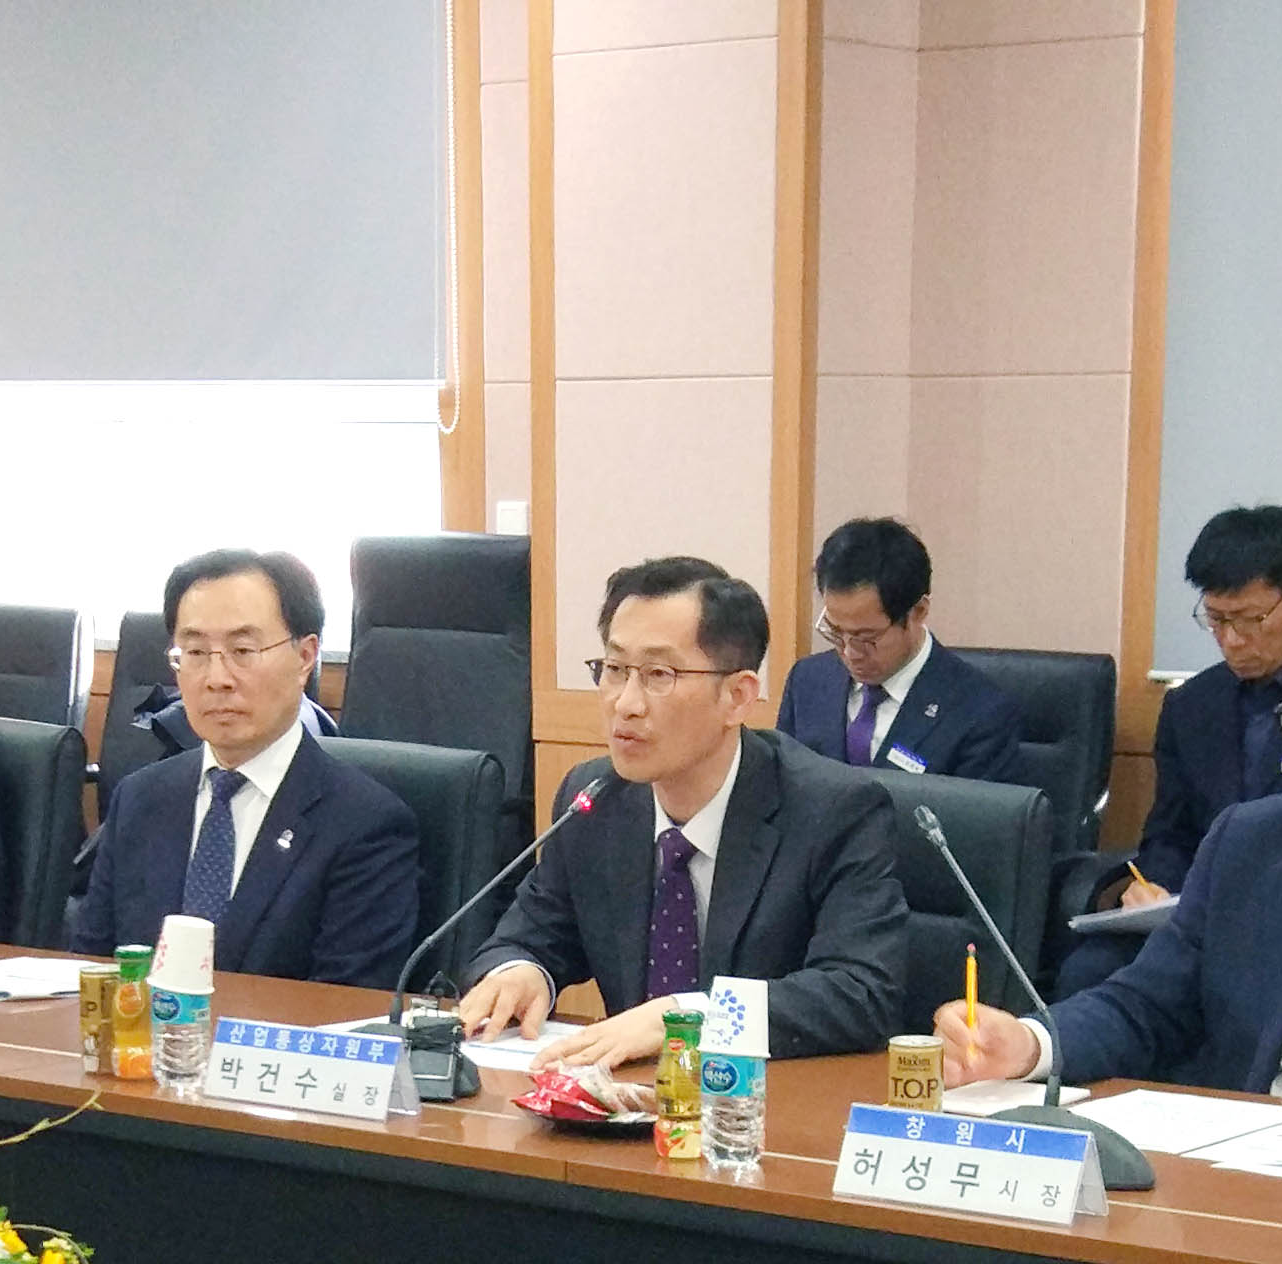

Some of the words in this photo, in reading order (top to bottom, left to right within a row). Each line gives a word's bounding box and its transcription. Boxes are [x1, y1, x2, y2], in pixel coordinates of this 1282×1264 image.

[229, 1024, 385, 1062] 산업통상자원부
[220, 1056, 317, 1099] 박건수
[332, 1082, 378, 1106] 실장
[906, 1115, 1026, 1152] 창원시
[853, 1148, 981, 1198] 허성무
[998, 1179, 1061, 1208] 시장
